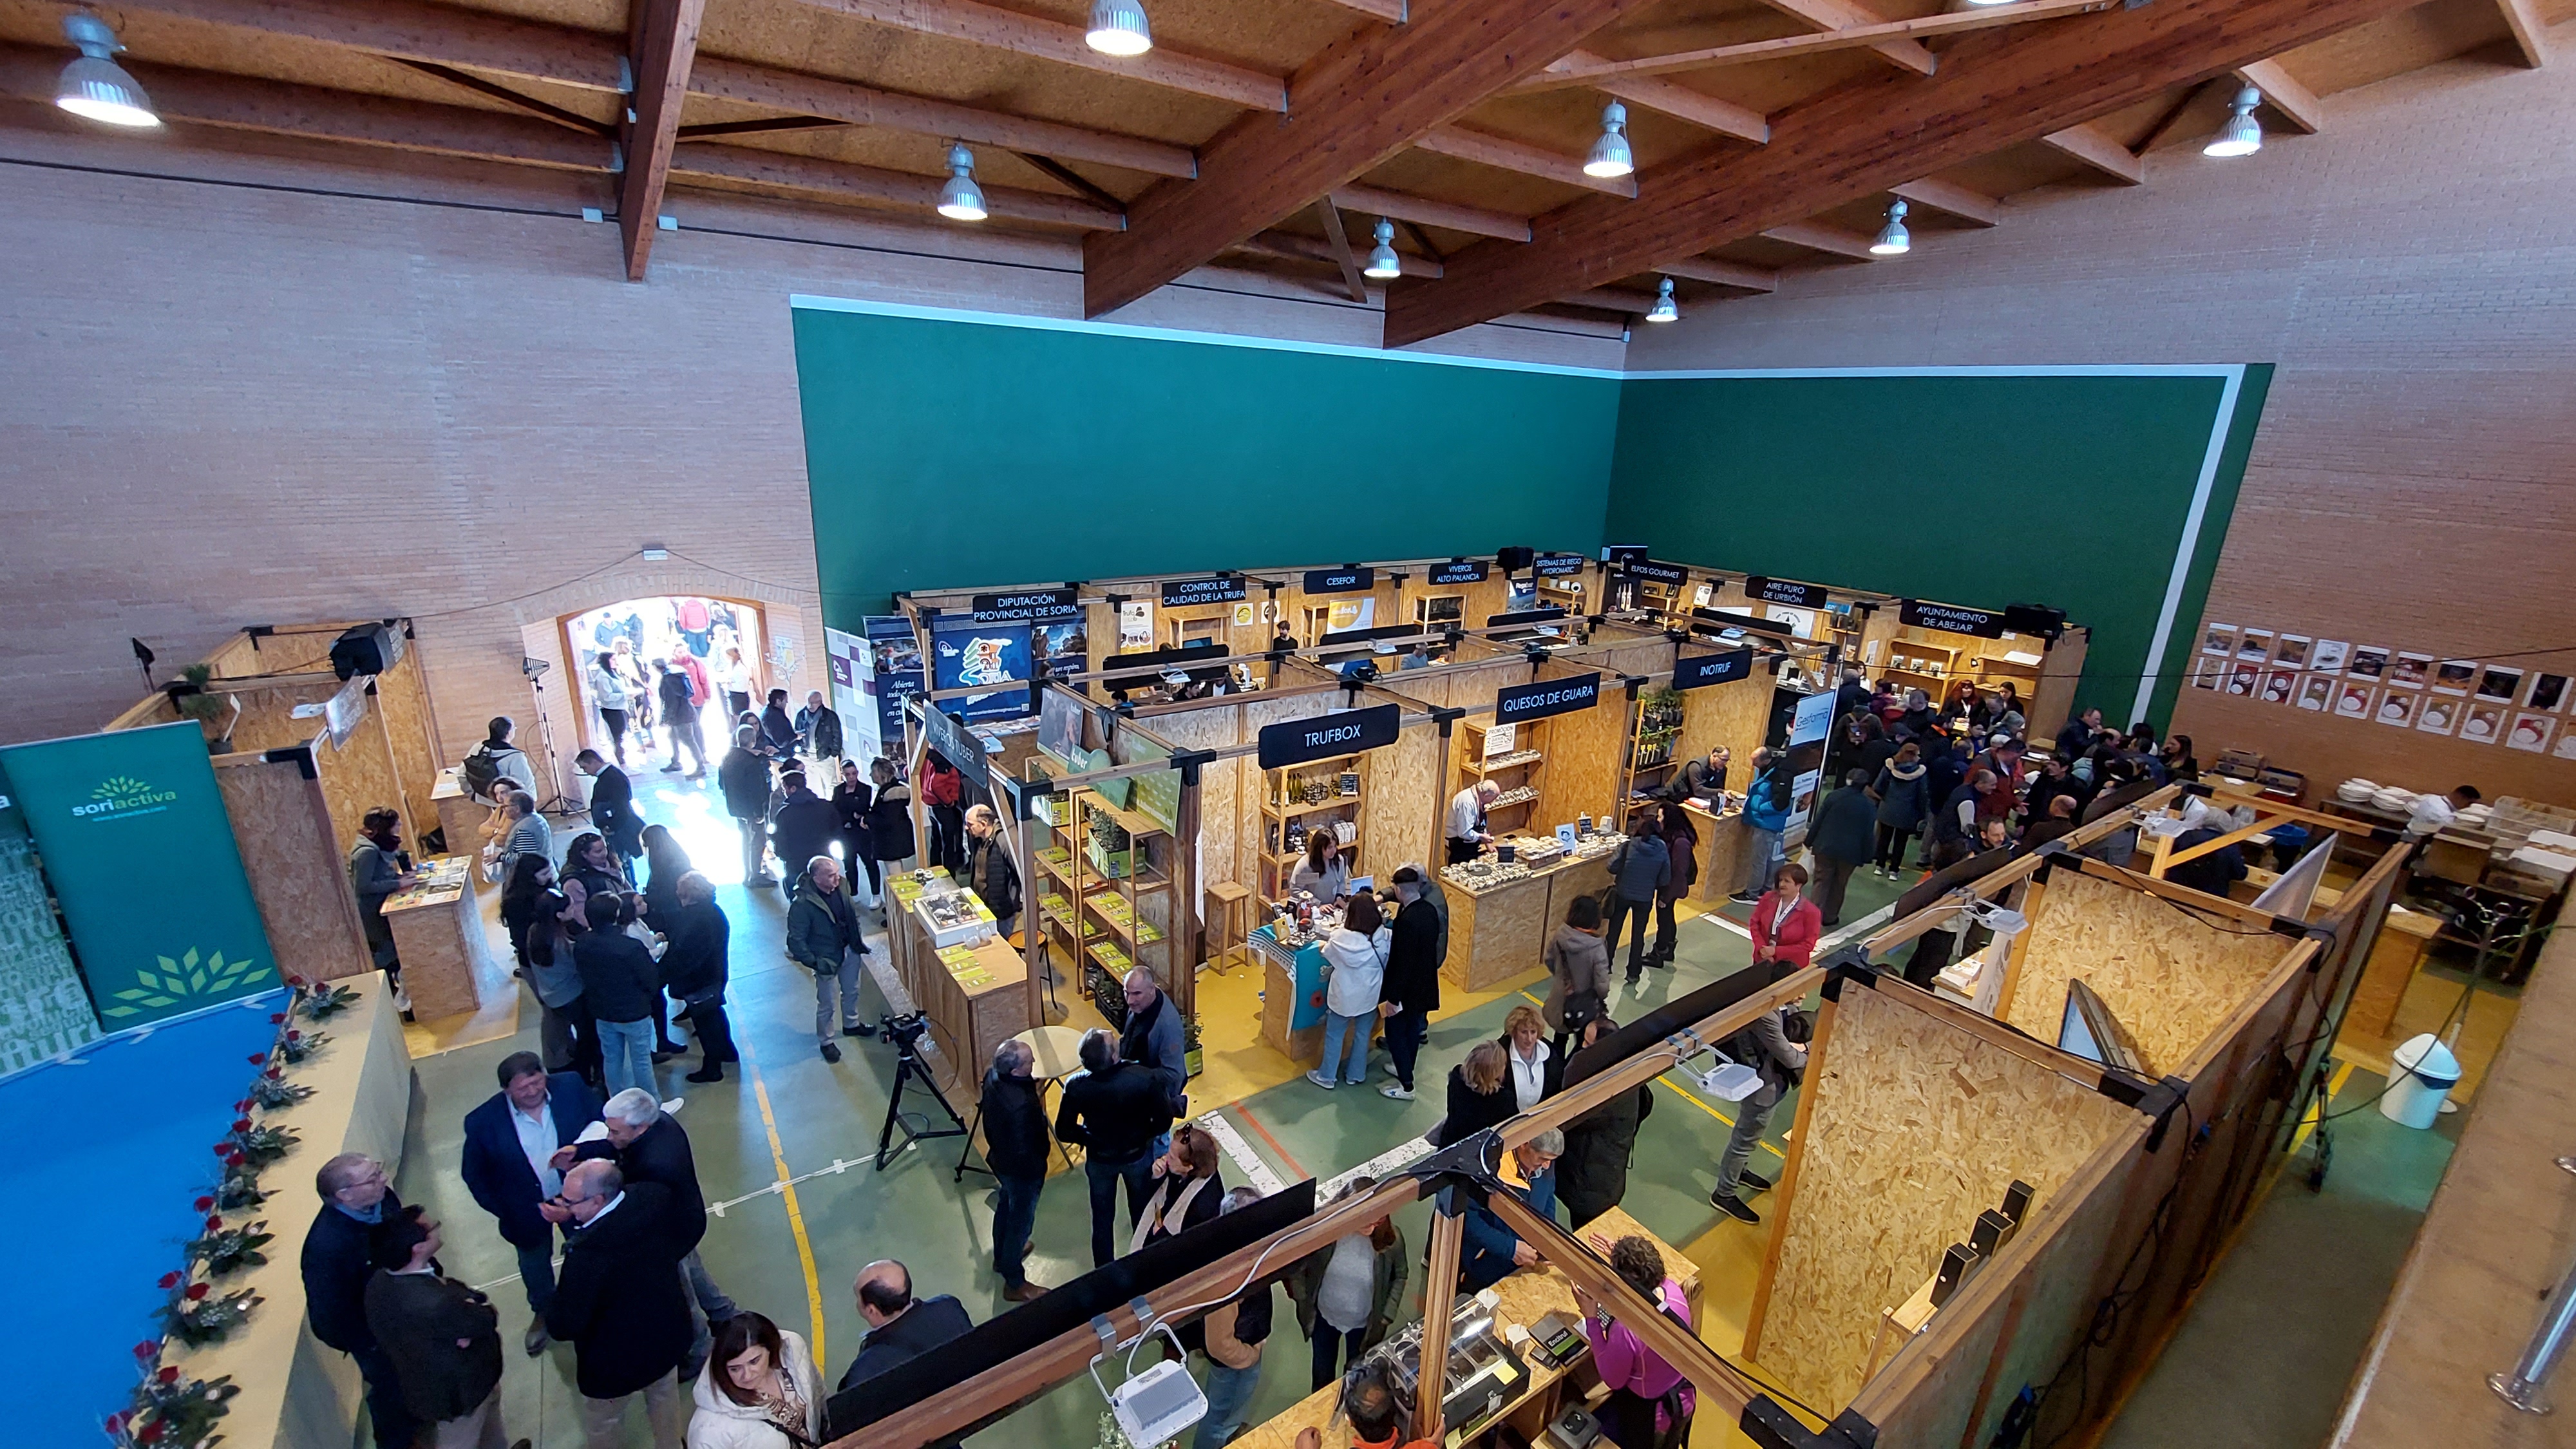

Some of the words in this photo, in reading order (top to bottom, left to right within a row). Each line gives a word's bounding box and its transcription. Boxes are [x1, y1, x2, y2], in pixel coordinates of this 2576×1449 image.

[1448, 565, 1472, 573] VIVEROS
[1536, 558, 1558, 567] SISTEMAS
[1558, 557, 1567, 565] DE
[1566, 557, 1582, 565] RIEGO
[1542, 566, 1575, 574] HYDROMATIC
[1631, 565, 1648, 574] ELFOS
[1648, 568, 1680, 578] GOURMET
[1326, 576, 1356, 586] CESEFOR
[1435, 574, 1452, 583] ALTO
[1179, 583, 1218, 592] CONTROL
[1219, 581, 1231, 589] DE
[1766, 582, 1783, 591] AIRE
[1783, 584, 1805, 594] PURO
[998, 594, 1056, 608] DIPUTACIÓN
[1162, 594, 1200, 605] CALIDAD
[1200, 593, 1211, 601] DE
[1212, 592, 1223, 600] LA
[1224, 590, 1245, 599] TRUFA
[1763, 591, 1773, 600] DE
[1774, 592, 1803, 604] URBIÓN
[973, 609, 1034, 621] PROVINCIAL
[1036, 607, 1049, 617] DE
[1050, 605, 1077, 616] SORIA
[1916, 606, 1987, 624] AYUNTAMIENTO
[1922, 617, 1935, 627] DE
[1935, 619, 1973, 632] ABEJAR
[1700, 661, 1732, 676] INOTRUF
[891, 680, 914, 689] Abierta
[1503, 696, 1546, 712] QUESOS
[1546, 693, 1560, 705] DE
[1561, 685, 1594, 703] GUARA
[932, 720, 955, 751] VIVEROS
[955, 741, 975, 764] TUBER
[1304, 724, 1361, 748] TRUFBOX
[1070, 747, 1088, 770] tuber
[72, 791, 177, 817] soriactiva
